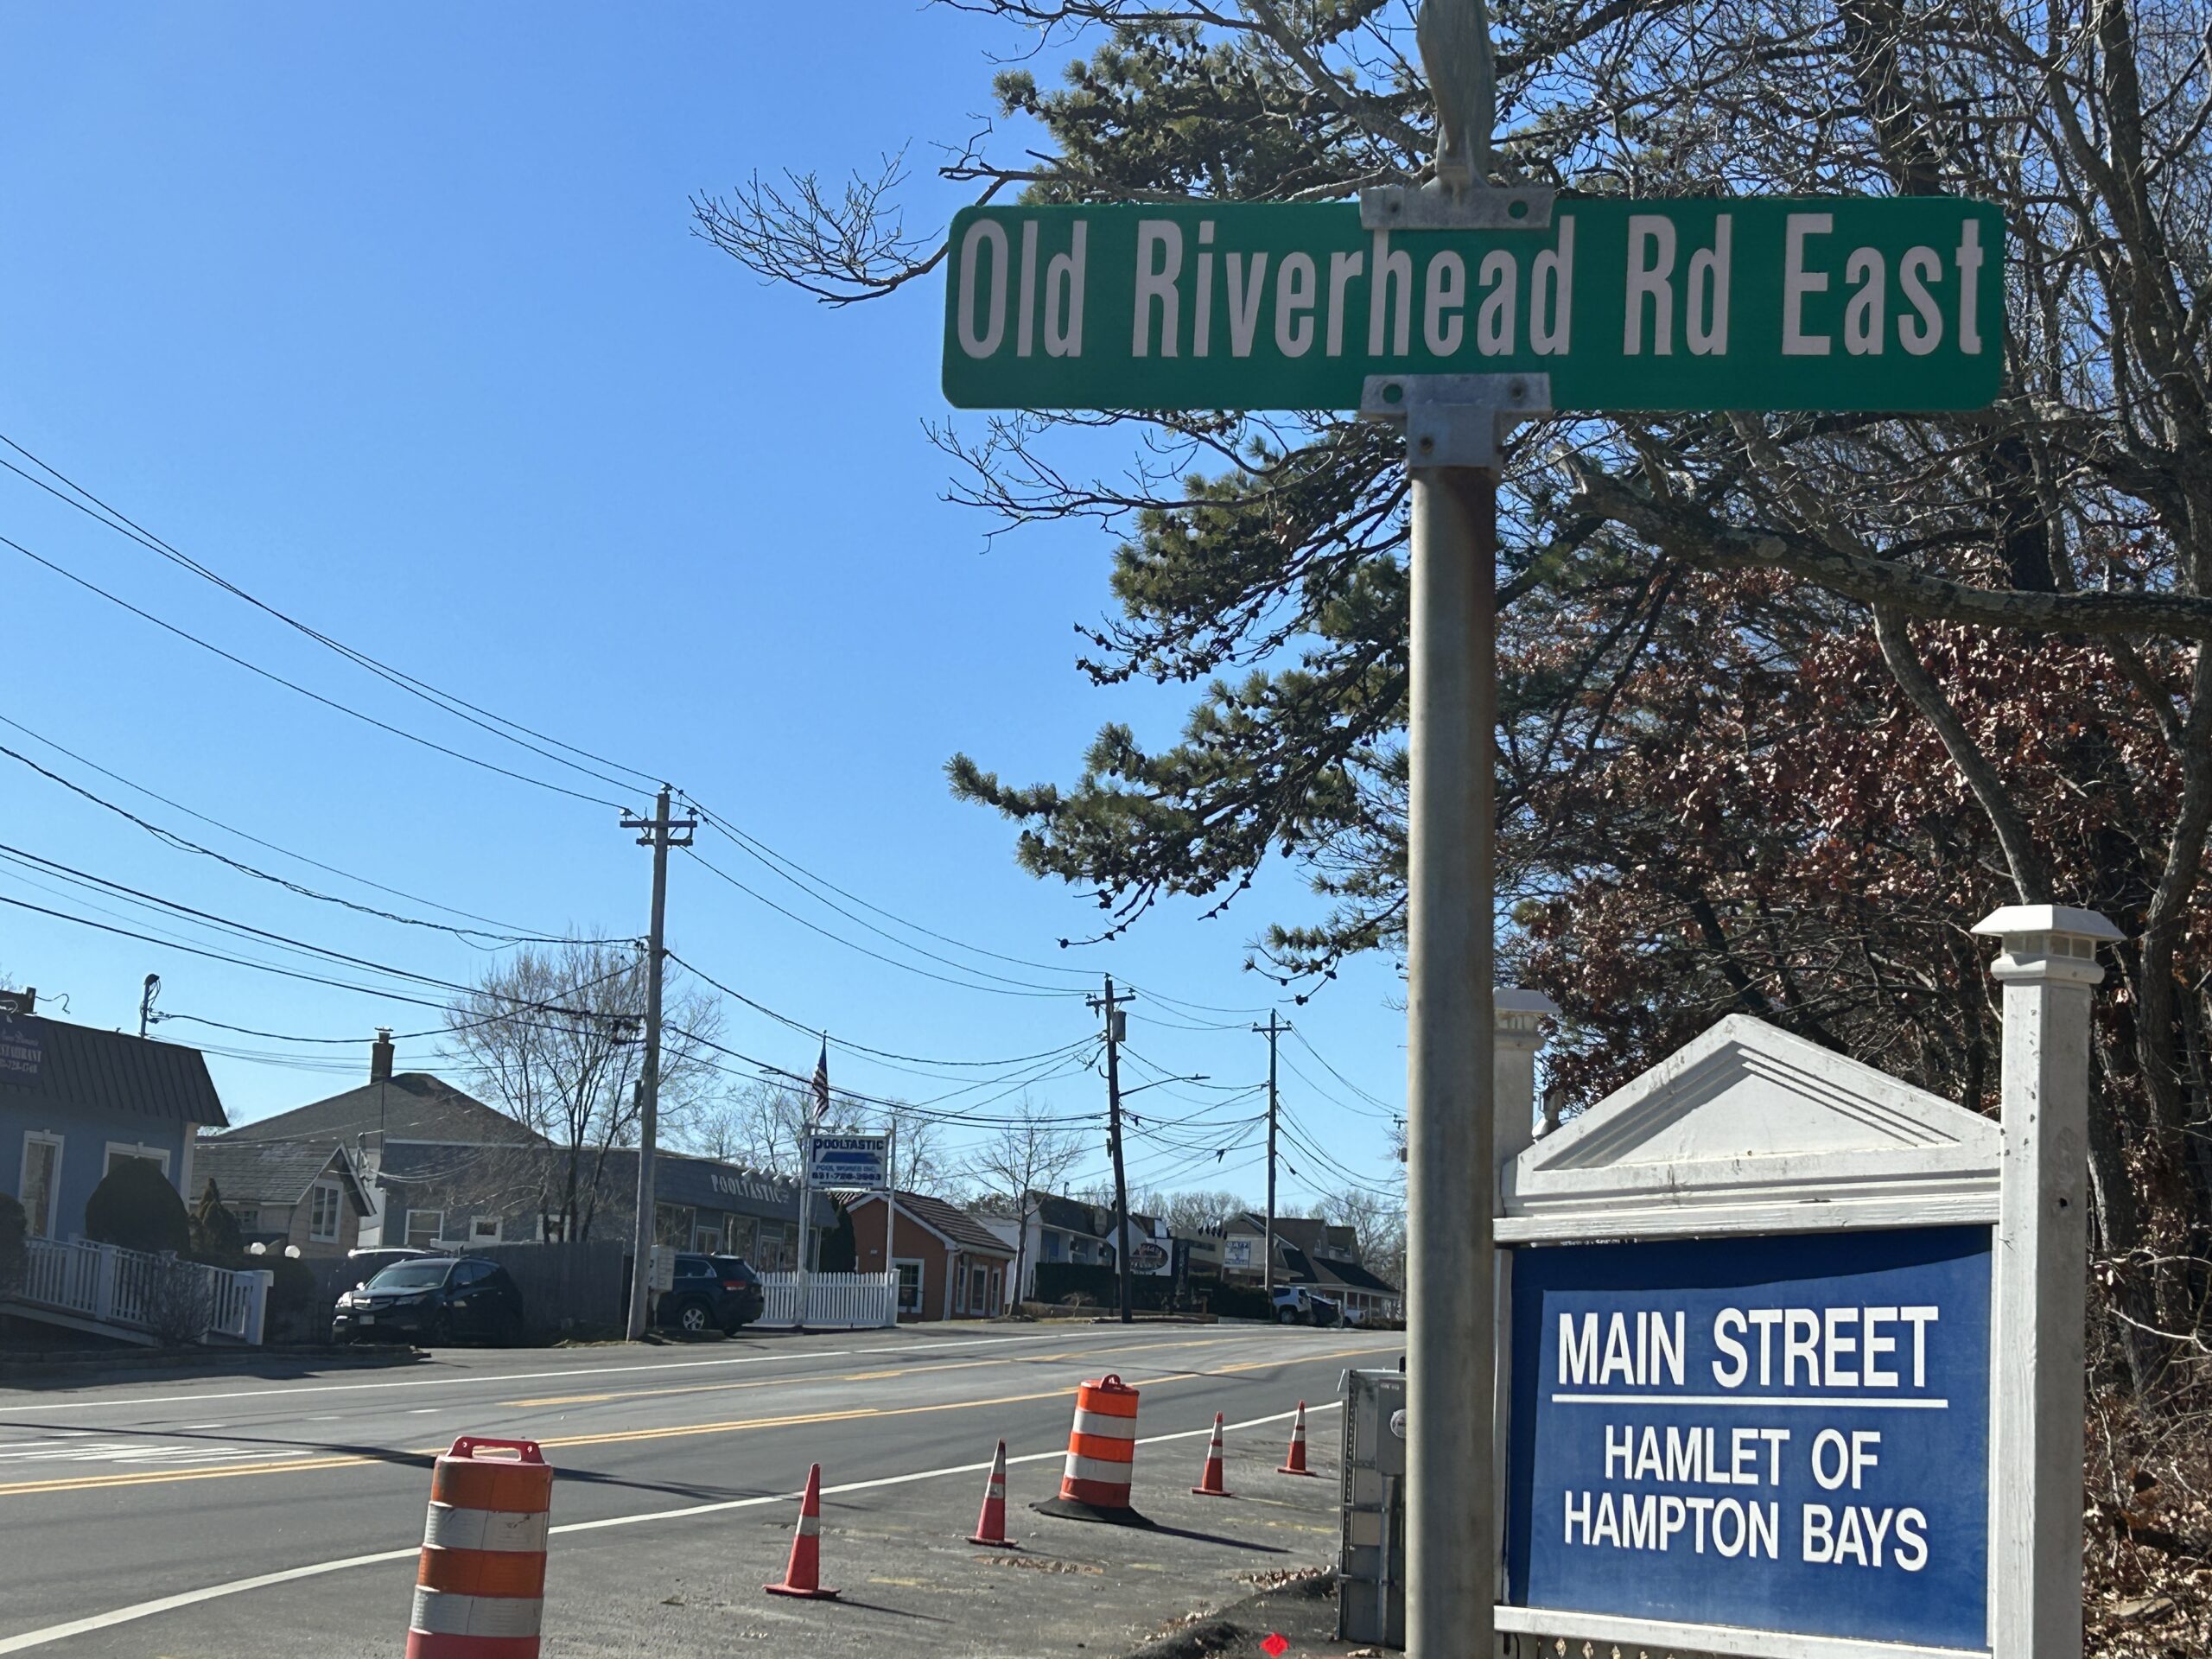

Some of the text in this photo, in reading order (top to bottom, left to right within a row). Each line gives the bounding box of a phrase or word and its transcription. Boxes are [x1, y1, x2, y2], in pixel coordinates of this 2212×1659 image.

[957, 213, 1984, 359] Old Riverhead Rd East
[710, 1174, 782, 1203] POOLTASTIC
[1558, 1306, 1939, 1389] MAIN STREET
[1605, 1425, 1881, 1490] HAMLET OF
[1564, 1491, 1928, 1572] HAMPTON BAYS
